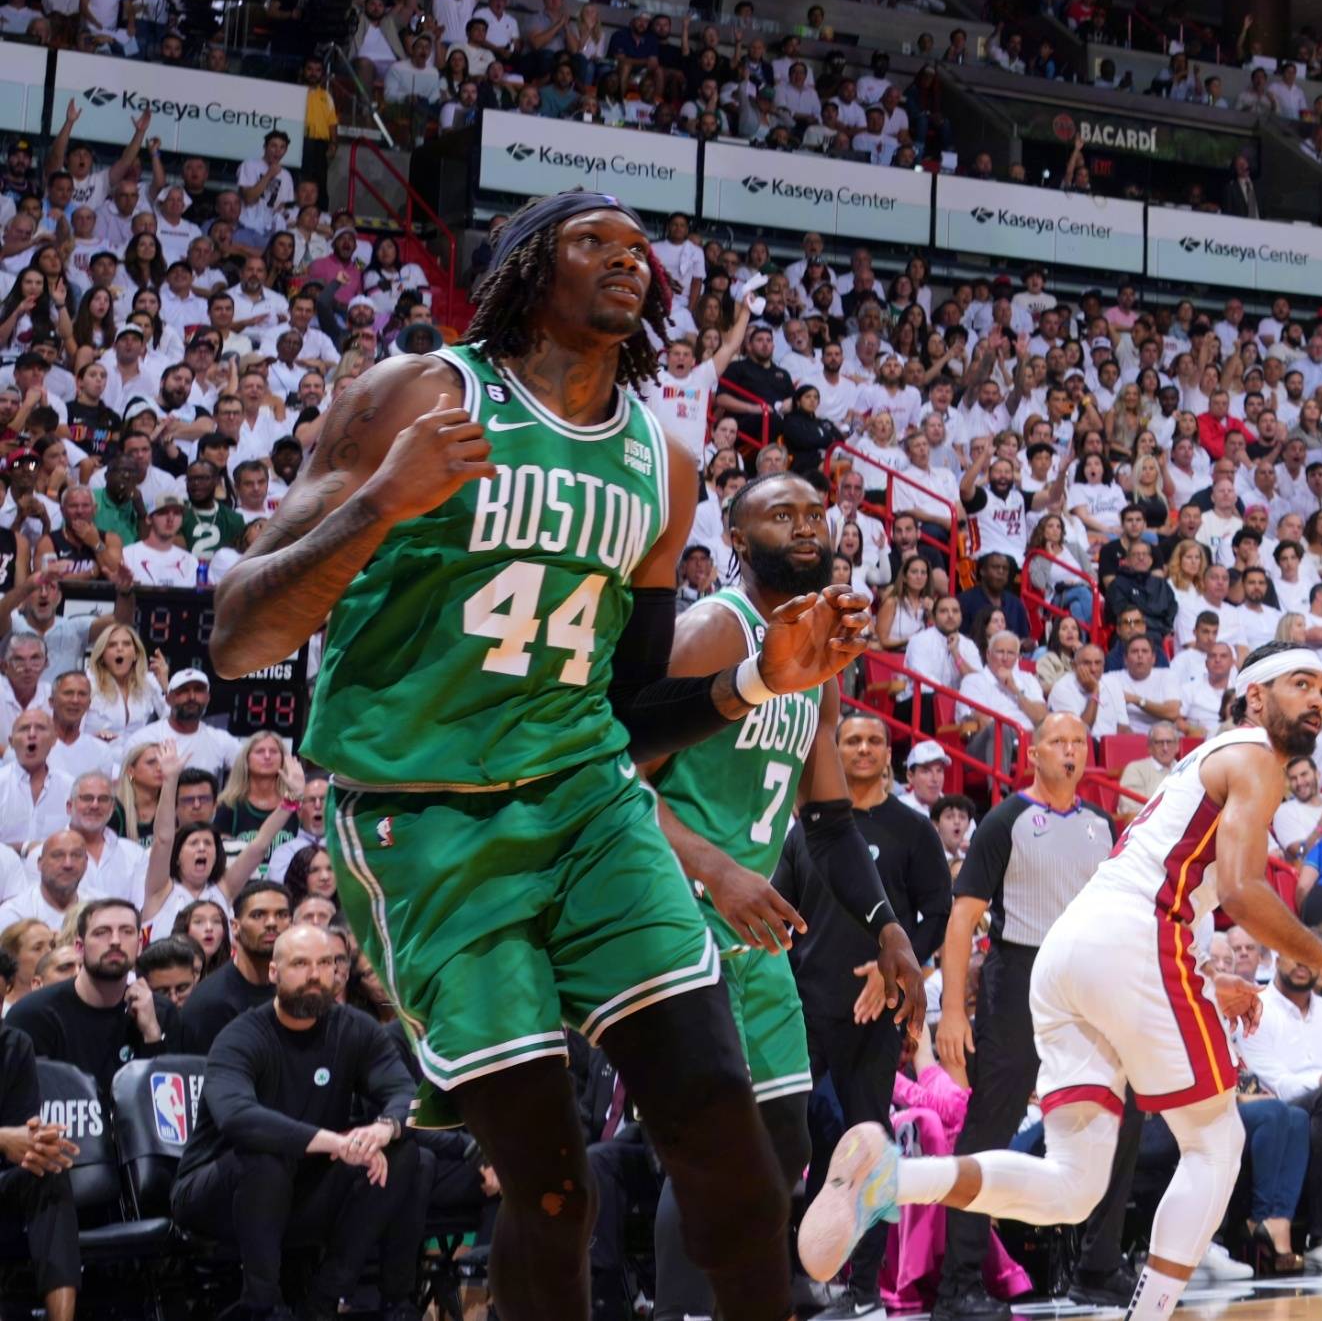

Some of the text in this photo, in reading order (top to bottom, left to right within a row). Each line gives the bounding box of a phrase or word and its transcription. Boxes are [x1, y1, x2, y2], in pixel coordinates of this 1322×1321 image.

[121, 88, 282, 131] Kaseya Center
[1080, 121, 1157, 153] BACARDÍ
[539, 144, 676, 182] Kaseya Center
[771, 178, 897, 212] Kaseya Center
[998, 209, 1112, 239] Kaseya Center
[1204, 238, 1309, 267] Kaseya Center
[487, 385, 506, 402] 6
[624, 438, 651, 463] VISTA
[624, 453, 653, 476] PRINT
[468, 464, 651, 586] BOSTON
[993, 504, 1022, 521] HEAT
[1006, 522, 1021, 536] 22
[192, 523, 221, 561] 2
[463, 561, 608, 686] 44
[735, 692, 820, 764] BOSTO
[750, 760, 792, 845] 7
